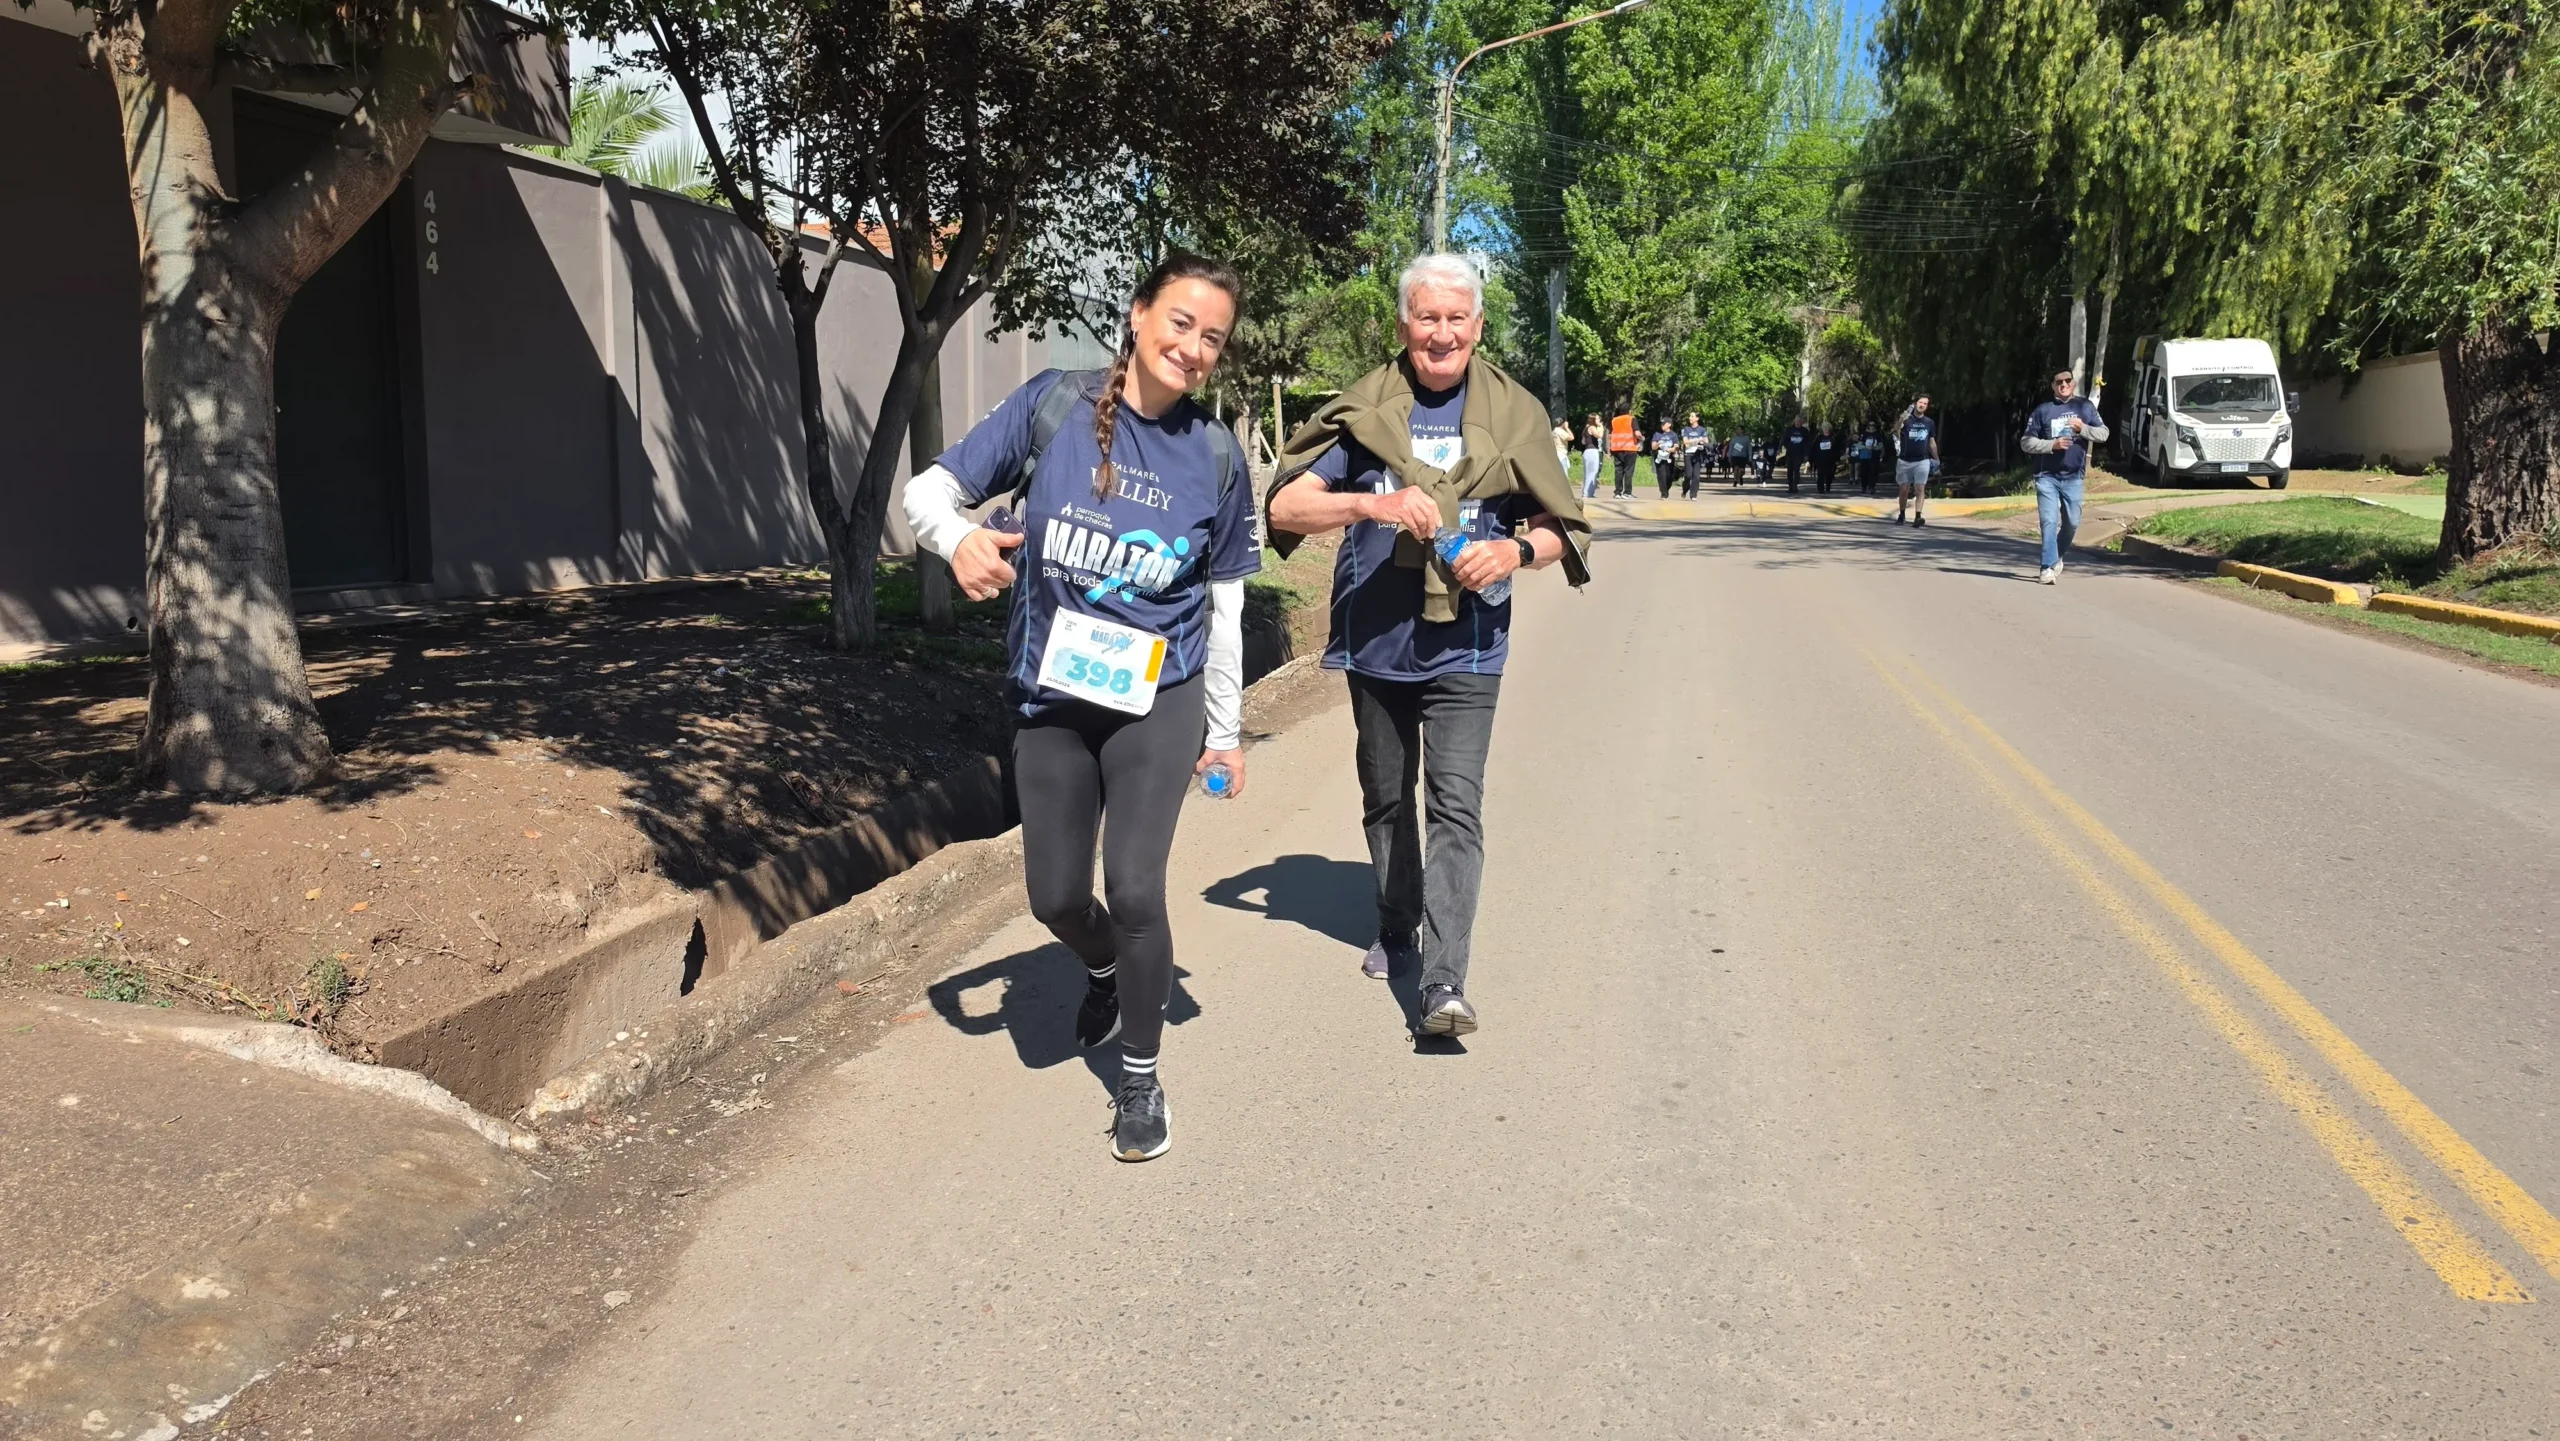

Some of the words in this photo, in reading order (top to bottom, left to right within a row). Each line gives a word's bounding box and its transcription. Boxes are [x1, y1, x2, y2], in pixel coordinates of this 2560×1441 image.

[423, 190, 439, 275] 464
[1412, 424, 1456, 433] PALMARES
[1090, 466, 1174, 511] VLLEY
[1074, 512, 1085, 520] de
[1085, 515, 1113, 530] chacras
[1076, 506, 1112, 523] parroquia
[1042, 565, 1070, 582] para
[1066, 654, 1133, 694] 398
